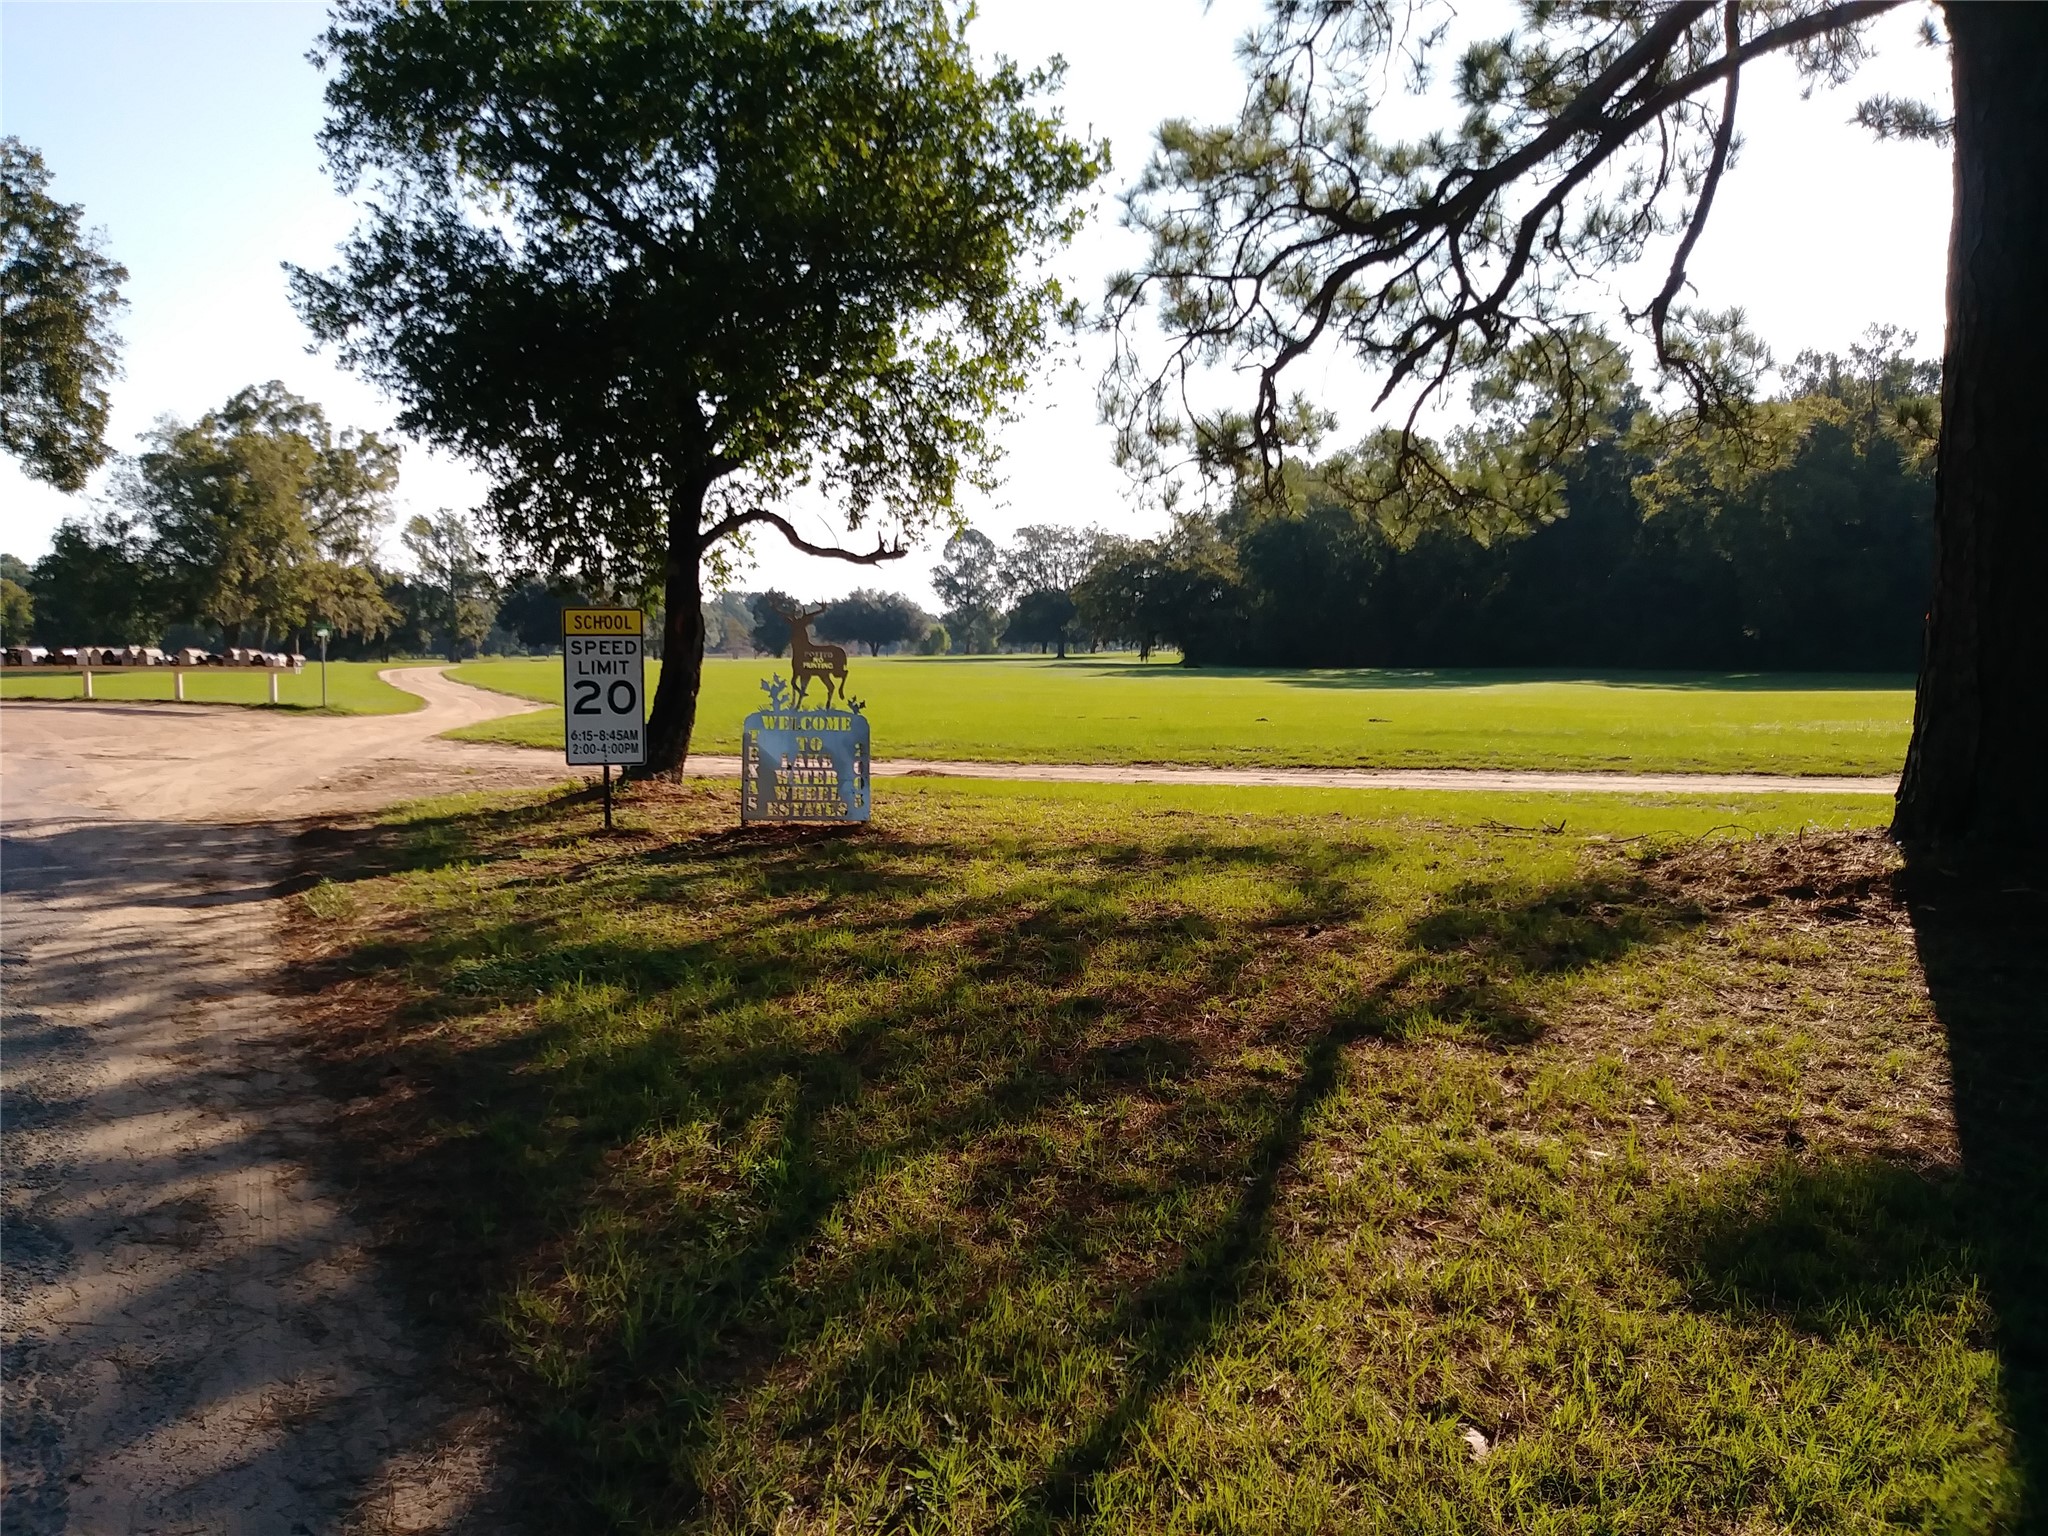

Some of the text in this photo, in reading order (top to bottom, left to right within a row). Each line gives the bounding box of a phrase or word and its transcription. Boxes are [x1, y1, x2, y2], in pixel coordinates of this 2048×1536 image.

[574, 615, 632, 631] SCHOOL
[571, 641, 637, 655] SPEED
[579, 660, 629, 675] LIMIT
[573, 680, 636, 715] 20
[762, 716, 852, 731] WELCOME
[571, 730, 639, 741] 6:15-8:45AM
[573, 743, 639, 754] 2:00-4:00PM
[796, 737, 823, 751] TO
[781, 753, 833, 768] LAKE
[775, 770, 839, 784] WATER
[774, 786, 841, 801] WHEEL
[766, 802, 848, 816] ESTATES
